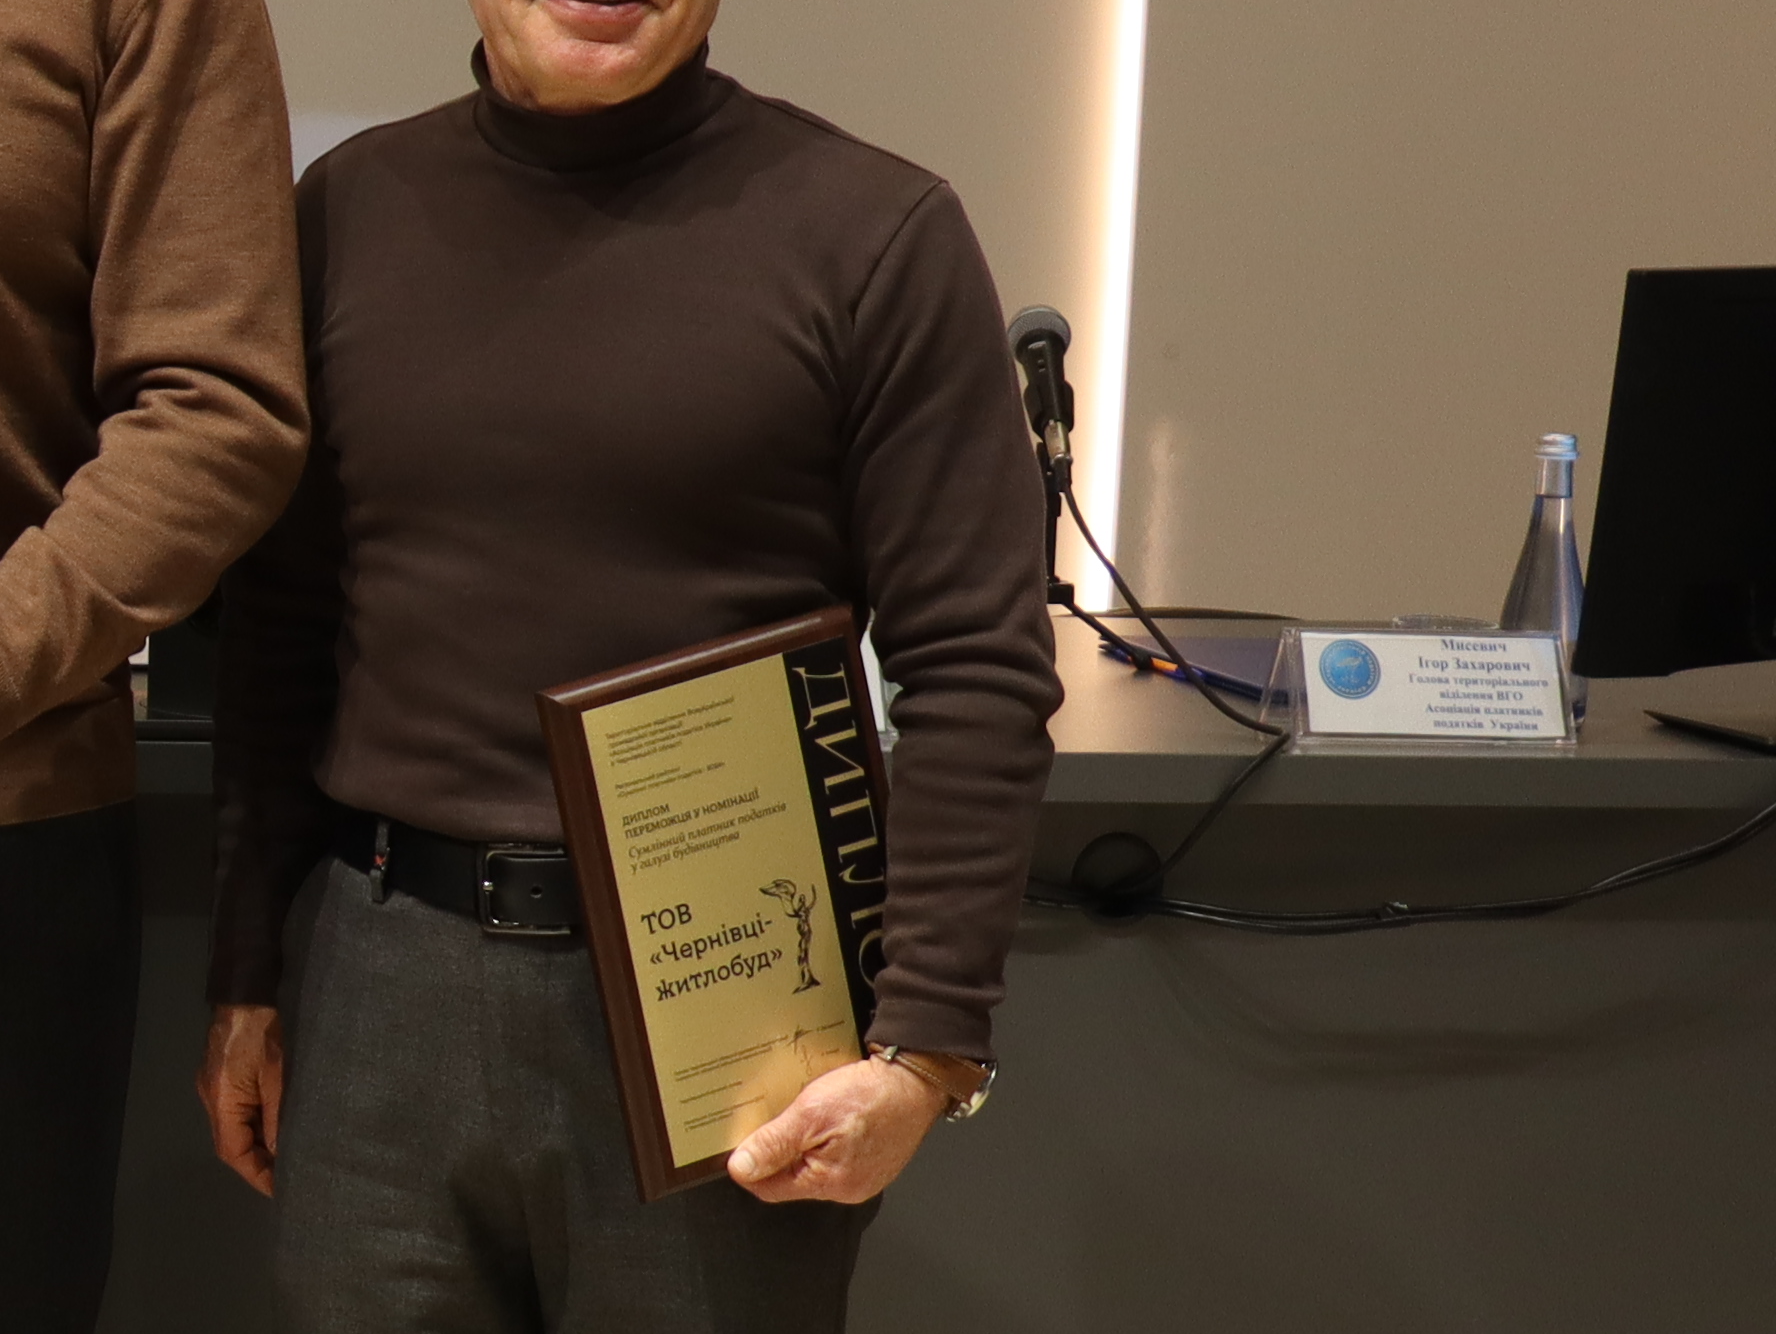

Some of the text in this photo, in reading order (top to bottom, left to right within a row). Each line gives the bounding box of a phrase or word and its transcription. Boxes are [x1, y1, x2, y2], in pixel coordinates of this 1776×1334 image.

[1441, 639, 1506, 652] Мисевич
[1418, 656, 1530, 673] Ігор Захарович
[1409, 673, 1548, 688] Голова територіального
[1497, 690, 1523, 701] ВГО
[1425, 703, 1543, 717] Асоціація платників
[1434, 718, 1538, 732] податків України
[622, 803, 669, 827] ДИПЛОМ
[624, 787, 759, 838] ПЕРЕМОЖЦЯ У НОМІНАЦІЇ
[628, 801, 786, 859] Сумлінний платник податків
[792, 663, 885, 1012] ДИПЛ
[630, 831, 739, 875] у галузі будівництва
[640, 903, 691, 934] ТОВ
[650, 913, 771, 963] «Чернівці-
[656, 949, 781, 1000] житлобуд»
